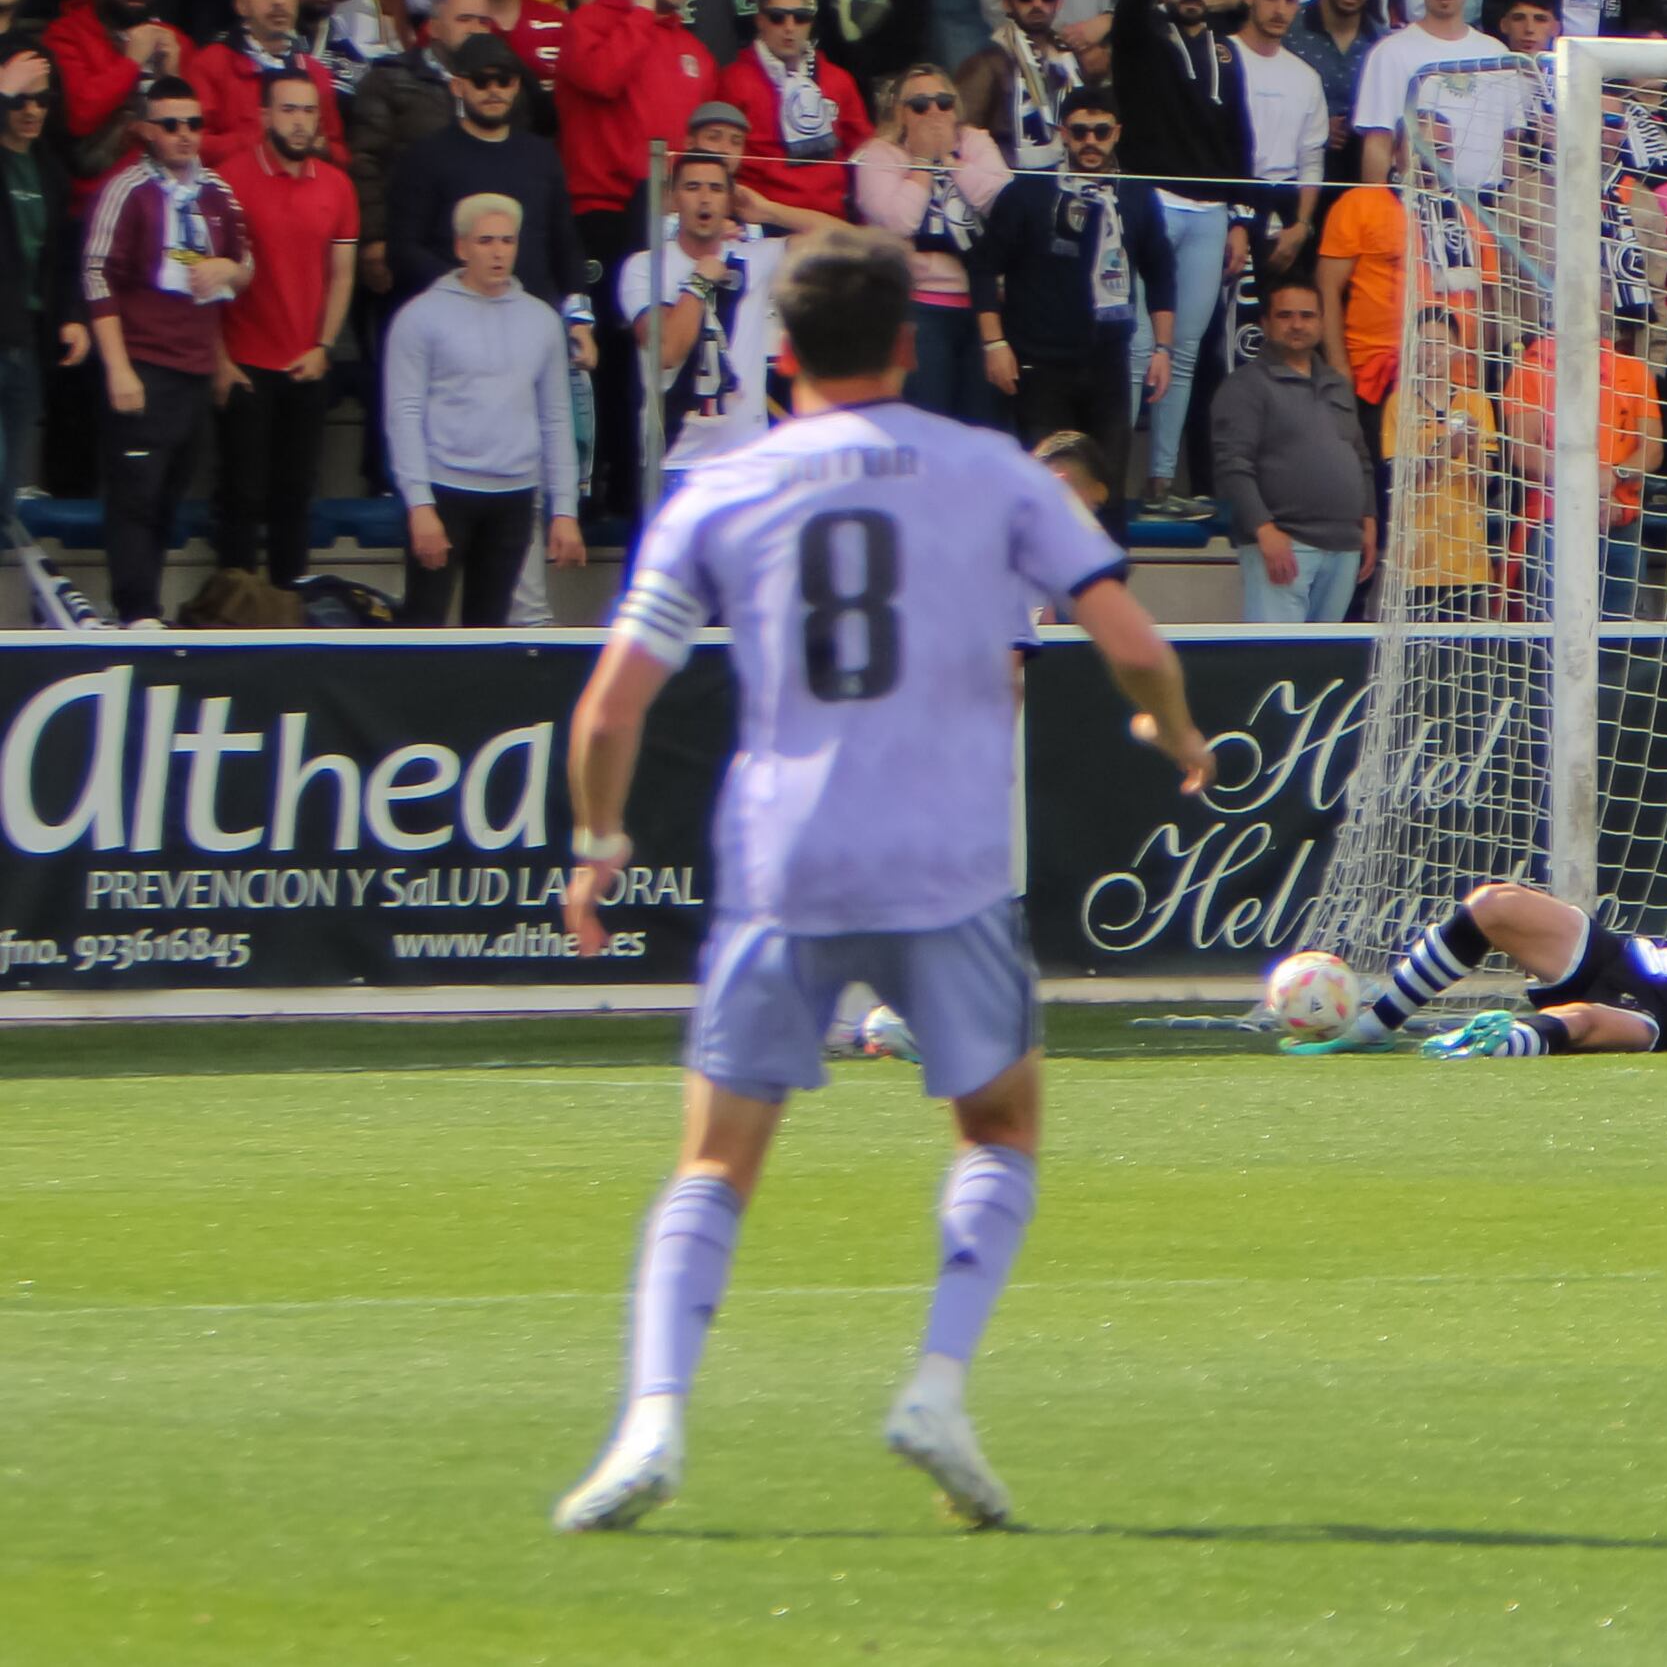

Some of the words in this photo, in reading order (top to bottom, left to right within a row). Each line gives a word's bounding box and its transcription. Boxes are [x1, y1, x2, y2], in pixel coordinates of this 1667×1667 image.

[801, 508, 904, 704] 8
[3, 664, 554, 854] althea
[86, 868, 339, 911] PREVENCION
[346, 867, 377, 908] Y
[516, 865, 705, 907] LAORAL
[73, 927, 251, 972] 923616845
[392, 922, 648, 959] www.althe.es
